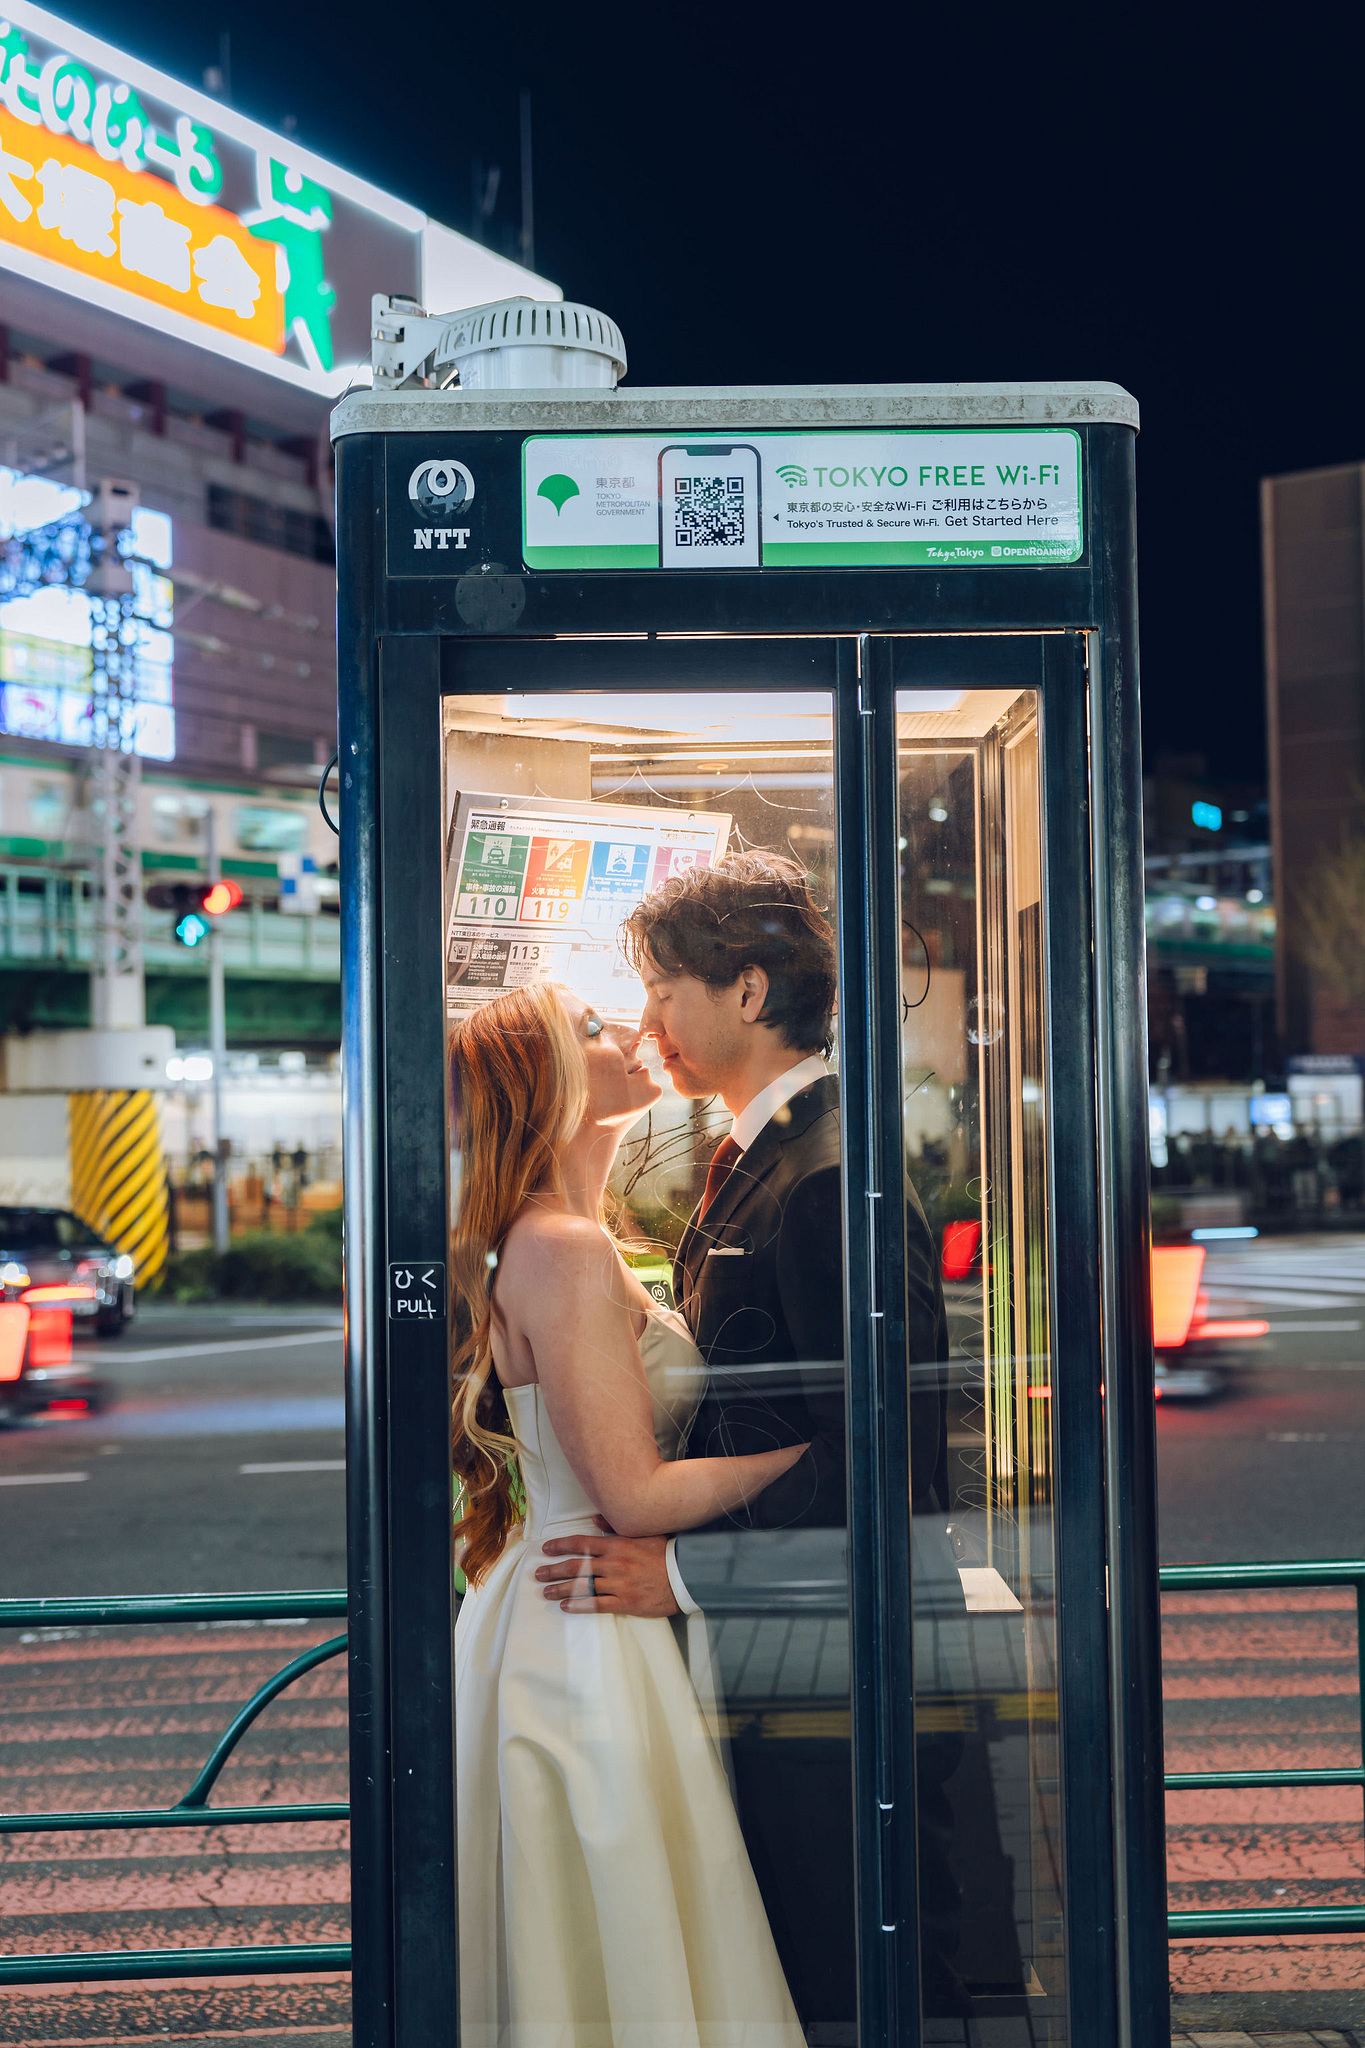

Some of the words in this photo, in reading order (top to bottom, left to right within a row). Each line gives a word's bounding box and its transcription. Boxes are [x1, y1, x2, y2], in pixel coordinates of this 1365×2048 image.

[595, 476, 635, 489] 東京都
[813, 465, 908, 487] TOKYO
[919, 465, 986, 487] FREE
[996, 464, 1060, 486] Wi-Fi
[595, 500, 651, 508] METROPOLITAN
[932, 498, 1048, 511] ご利用はこちらから
[596, 508, 646, 516] GOVERNMENT
[787, 520, 824, 530] Tokyo's
[826, 519, 864, 528] Trusted
[866, 520, 874, 528] &
[877, 519, 911, 528] Secure
[913, 518, 940, 527] Wi-Fi.
[945, 515, 968, 527] Get
[972, 515, 1022, 527] Started
[1026, 514, 1059, 526] Here
[413, 528, 470, 549] NTT
[955, 547, 985, 559] Tokyo
[470, 819, 506, 831] 緊急通報
[470, 896, 507, 916] 110
[534, 900, 570, 919] 119
[511, 944, 540, 960] 113
[395, 1269, 437, 1289] ひく
[397, 1299, 437, 1313] PULL
